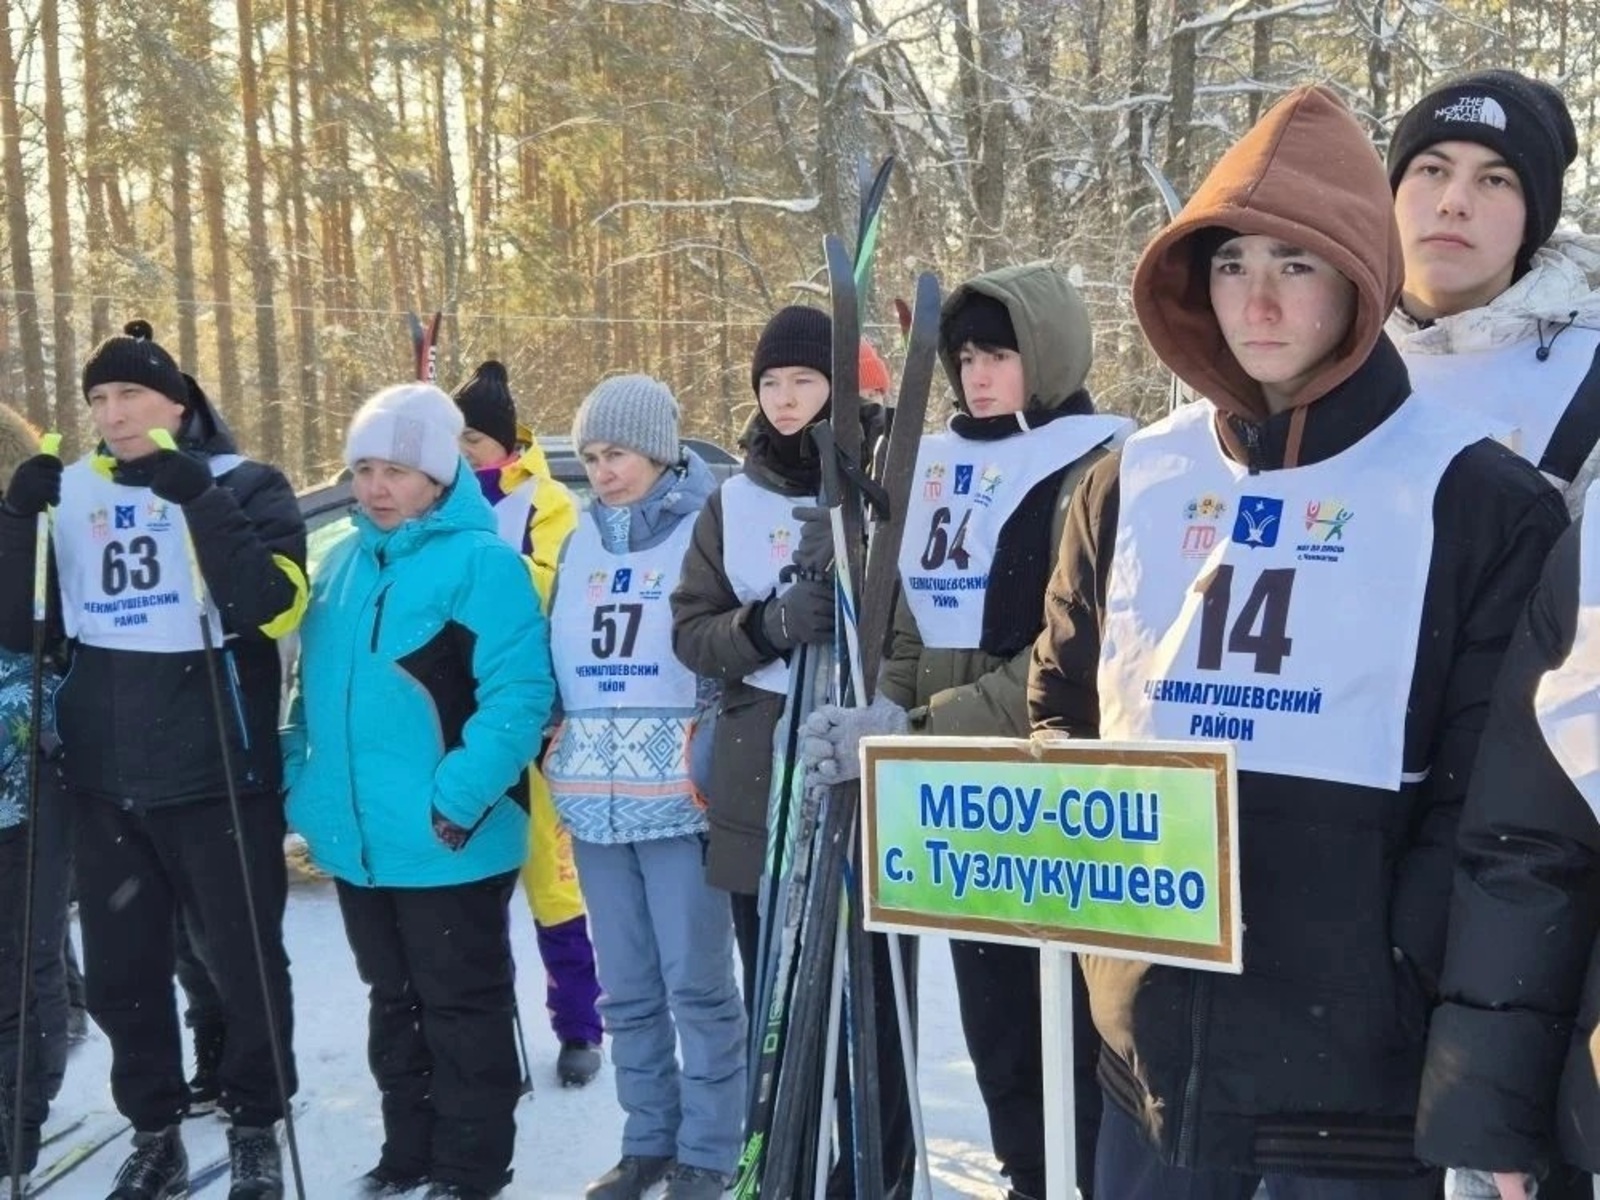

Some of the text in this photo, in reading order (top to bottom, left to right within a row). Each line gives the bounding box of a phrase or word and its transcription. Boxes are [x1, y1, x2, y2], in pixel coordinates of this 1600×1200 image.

[1435, 104, 1483, 118] NORTH
[1459, 97, 1483, 105] THE
[1445, 113, 1481, 123] FACE
[921, 507, 972, 570] 64
[1181, 525, 1217, 550] ГТО
[102, 535, 161, 596] 63
[84, 590, 180, 614] ЧЕКМАГУШЕВСКИЙ
[114, 613, 148, 627] РАЙОН
[591, 603, 643, 659] 57
[1193, 564, 1296, 675] 14
[1144, 679, 1322, 714] ЧЕКМАГУШЕВСКИЙ
[1190, 712, 1254, 741] РАЙОН
[920, 784, 1158, 841] МБОУ-СОШ
[886, 841, 1205, 910] с. Тузлукушево
